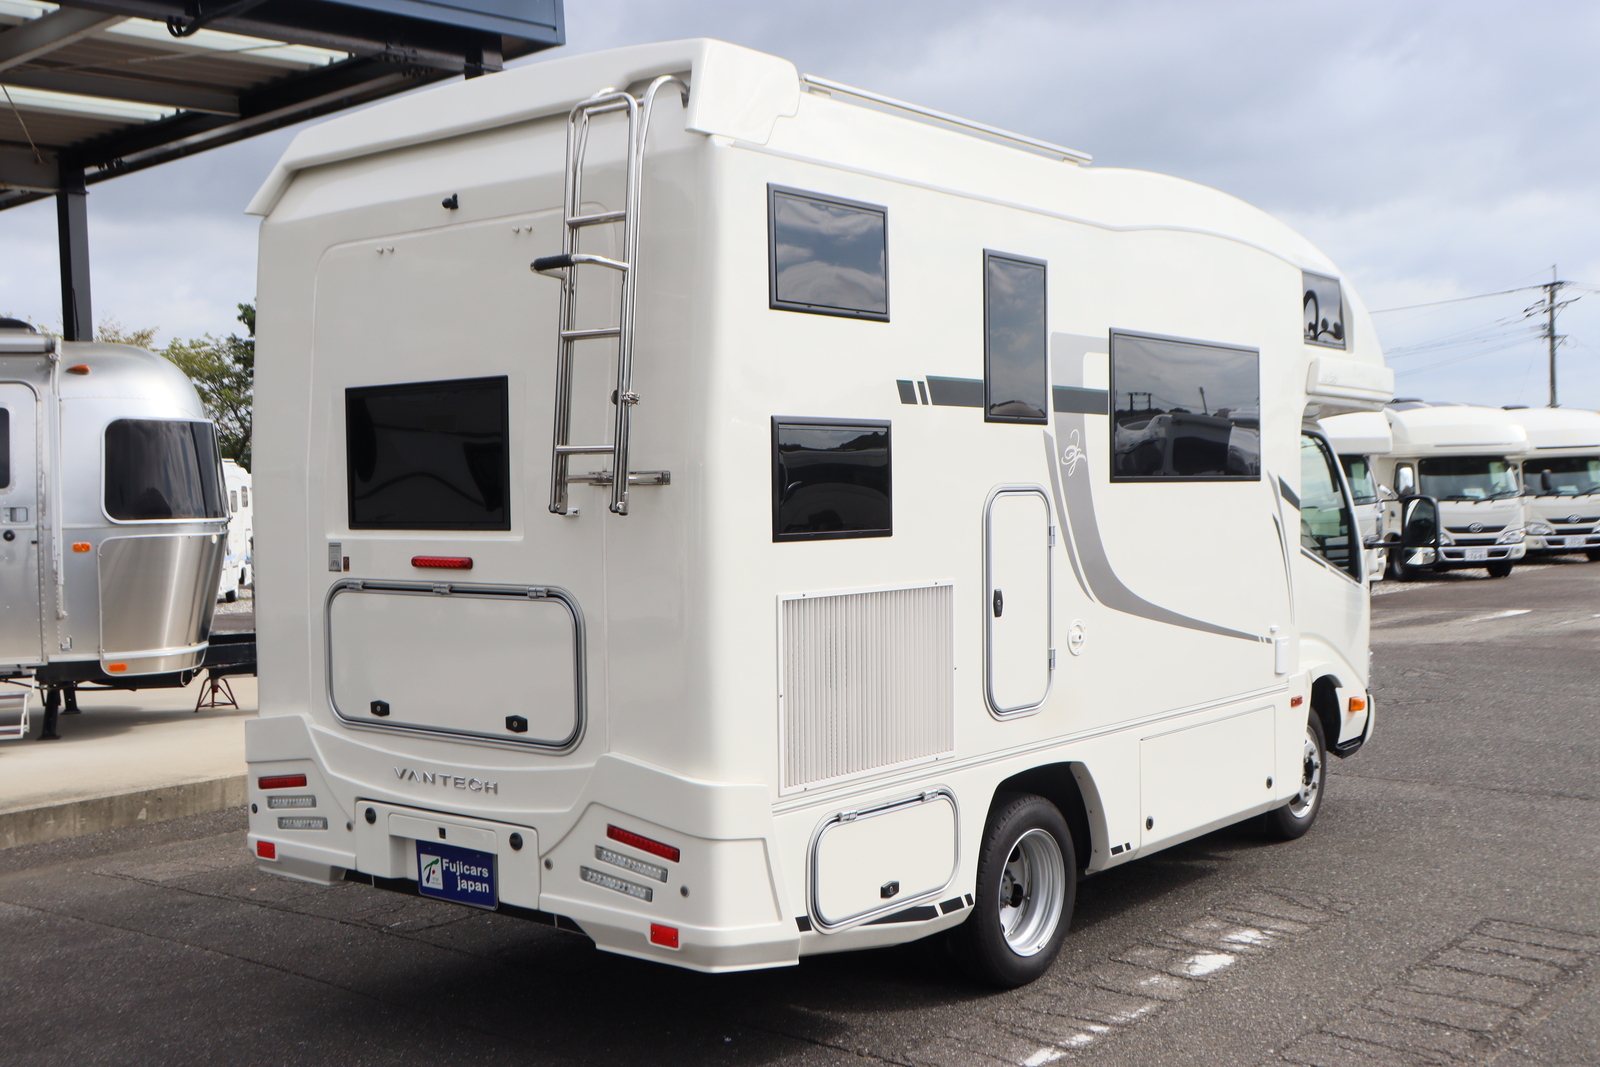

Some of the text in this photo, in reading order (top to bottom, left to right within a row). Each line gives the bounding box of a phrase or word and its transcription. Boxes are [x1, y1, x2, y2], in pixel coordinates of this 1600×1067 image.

[394, 766, 499, 796] VANTECH
[442, 858, 490, 878] Fujicars
[456, 876, 490, 894] japan
